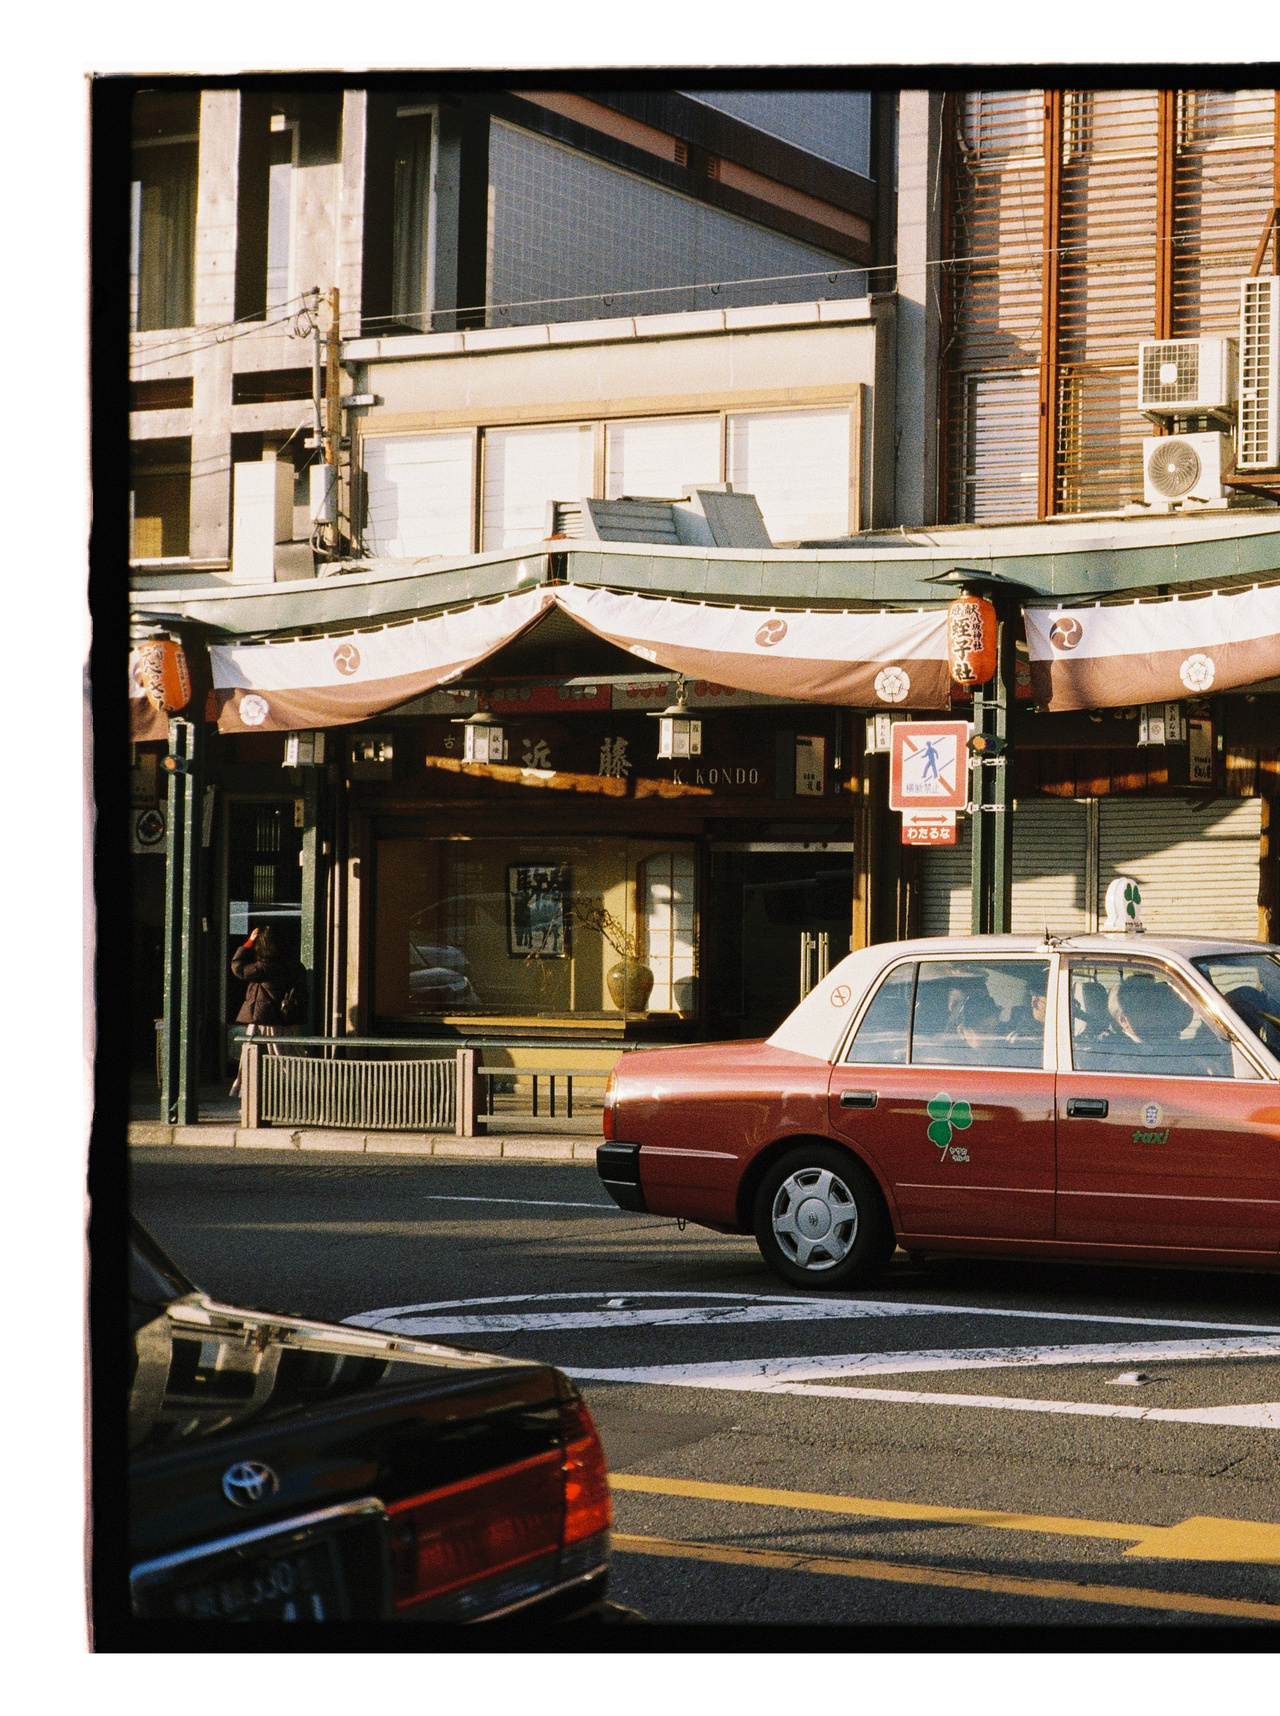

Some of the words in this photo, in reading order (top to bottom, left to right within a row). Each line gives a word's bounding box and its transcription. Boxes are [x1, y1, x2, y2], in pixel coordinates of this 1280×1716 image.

[696, 767, 759, 784] KONDO
[906, 782, 940, 795] 横断禁止
[907, 827, 950, 839] わたるな
[1132, 1128, 1170, 1144] taxi
